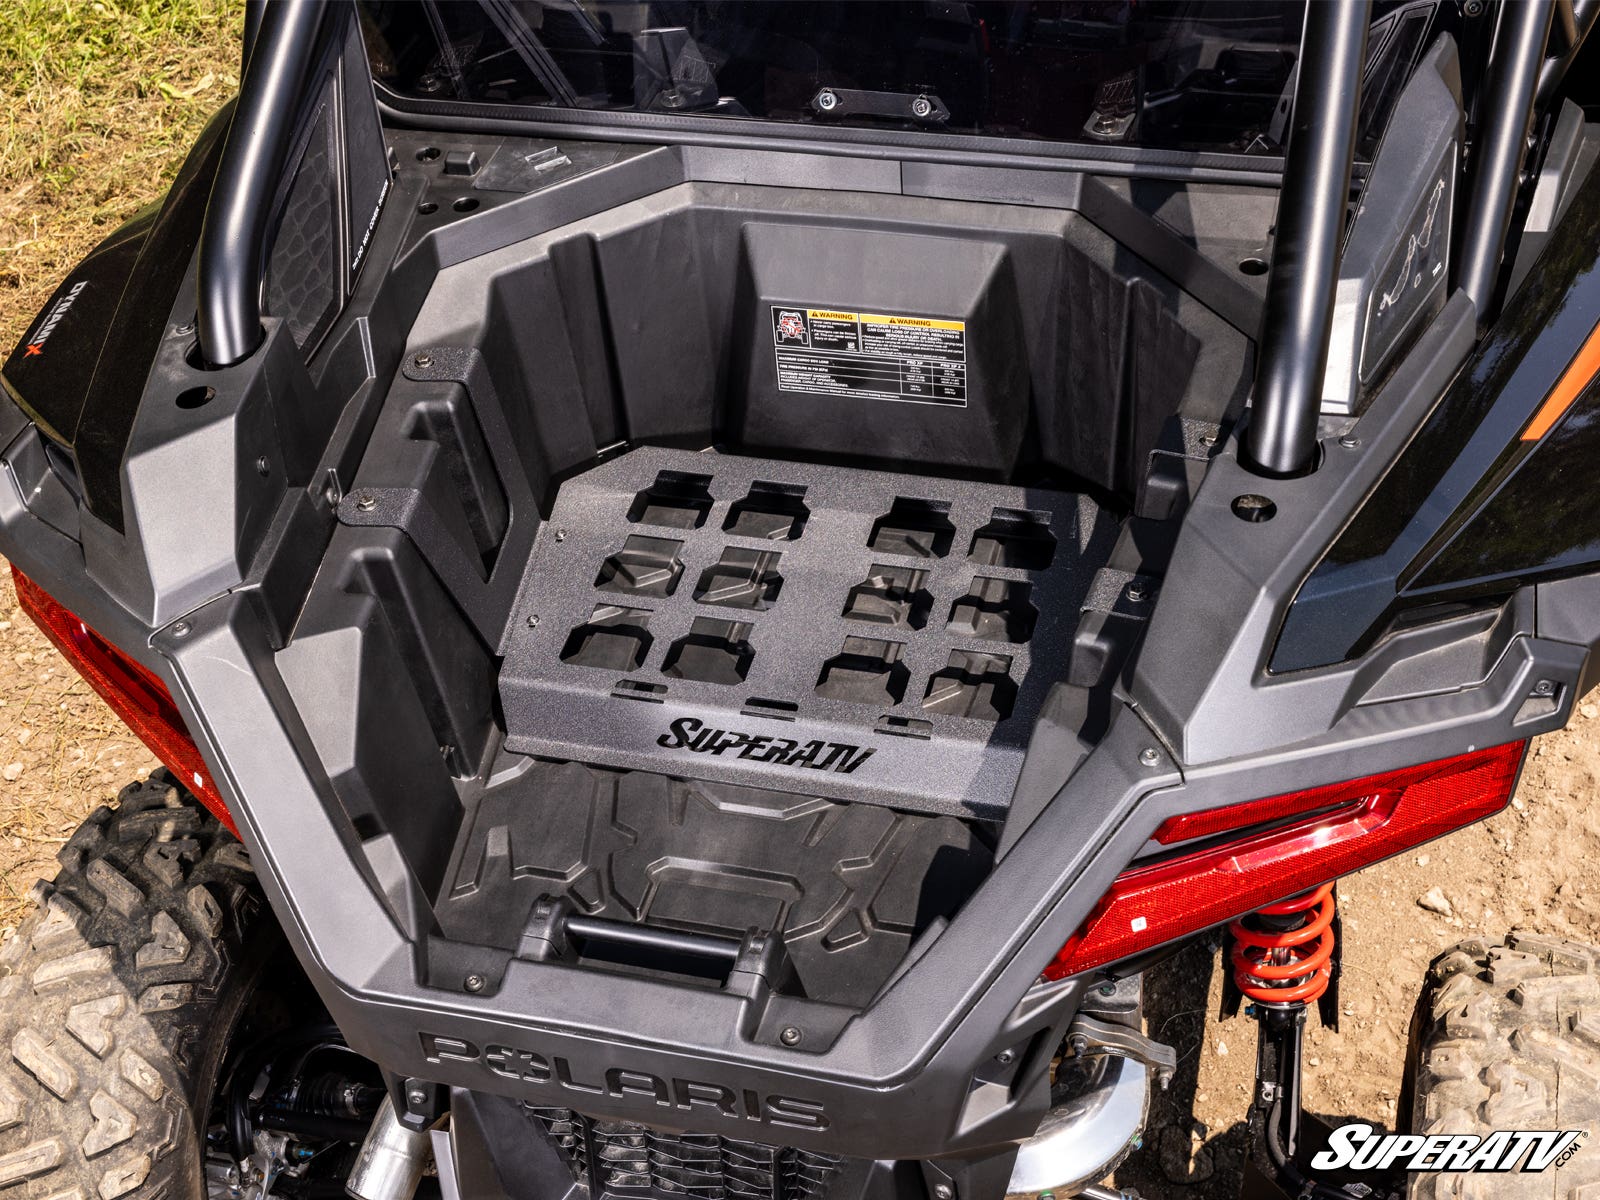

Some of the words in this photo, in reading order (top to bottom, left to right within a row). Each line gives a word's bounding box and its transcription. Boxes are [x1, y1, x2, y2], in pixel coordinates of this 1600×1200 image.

[819, 311, 853, 321] WARNING
[896, 318, 931, 327] WARNING
[657, 717, 877, 774] SUPERATV
[418, 1031, 831, 1132] POLARIS
